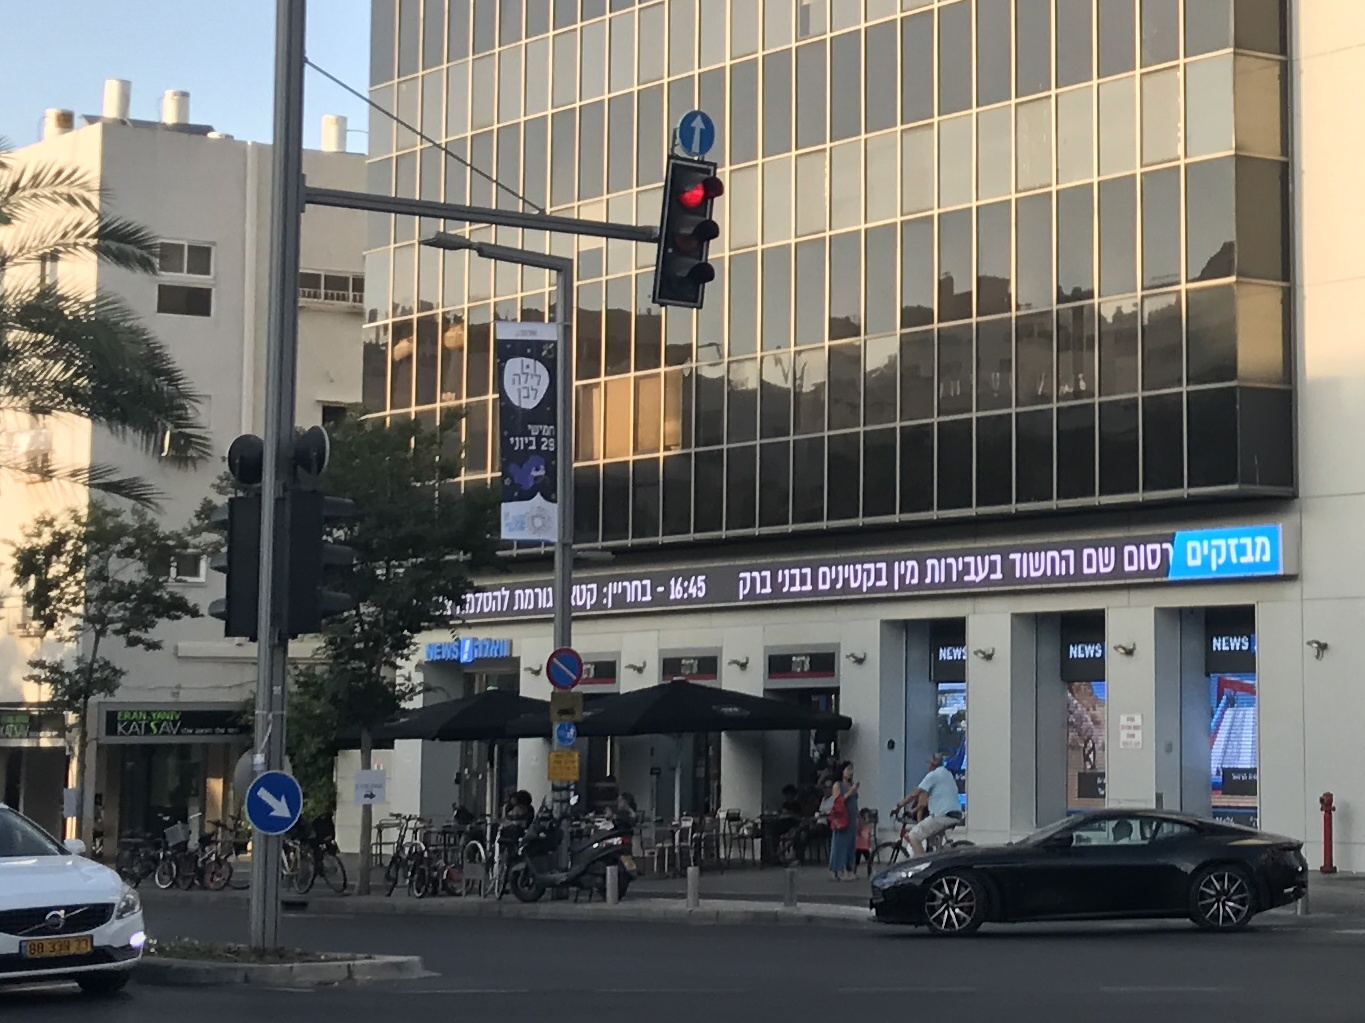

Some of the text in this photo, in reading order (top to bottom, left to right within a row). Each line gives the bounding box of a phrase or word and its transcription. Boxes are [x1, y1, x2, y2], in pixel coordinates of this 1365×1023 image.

[509, 437, 536, 451] ביוני
[1009, 549, 1075, 579] החשוד
[1083, 546, 1115, 575] שם
[1186, 535, 1271, 572] מבזקים
[777, 567, 812, 593] בבני
[818, 562, 888, 593] בקטינים
[894, 560, 919, 591] מין
[925, 554, 1003, 584] בעבירות
[513, 587, 553, 610] גורמת
[603, 579, 652, 609] בחריין:
[669, 574, 706, 600] 16:45
[739, 570, 772, 601] ברק
[426, 641, 460, 661] NEWS
[1069, 643, 1102, 659] NEWS
[1212, 635, 1249, 652] NEWS
